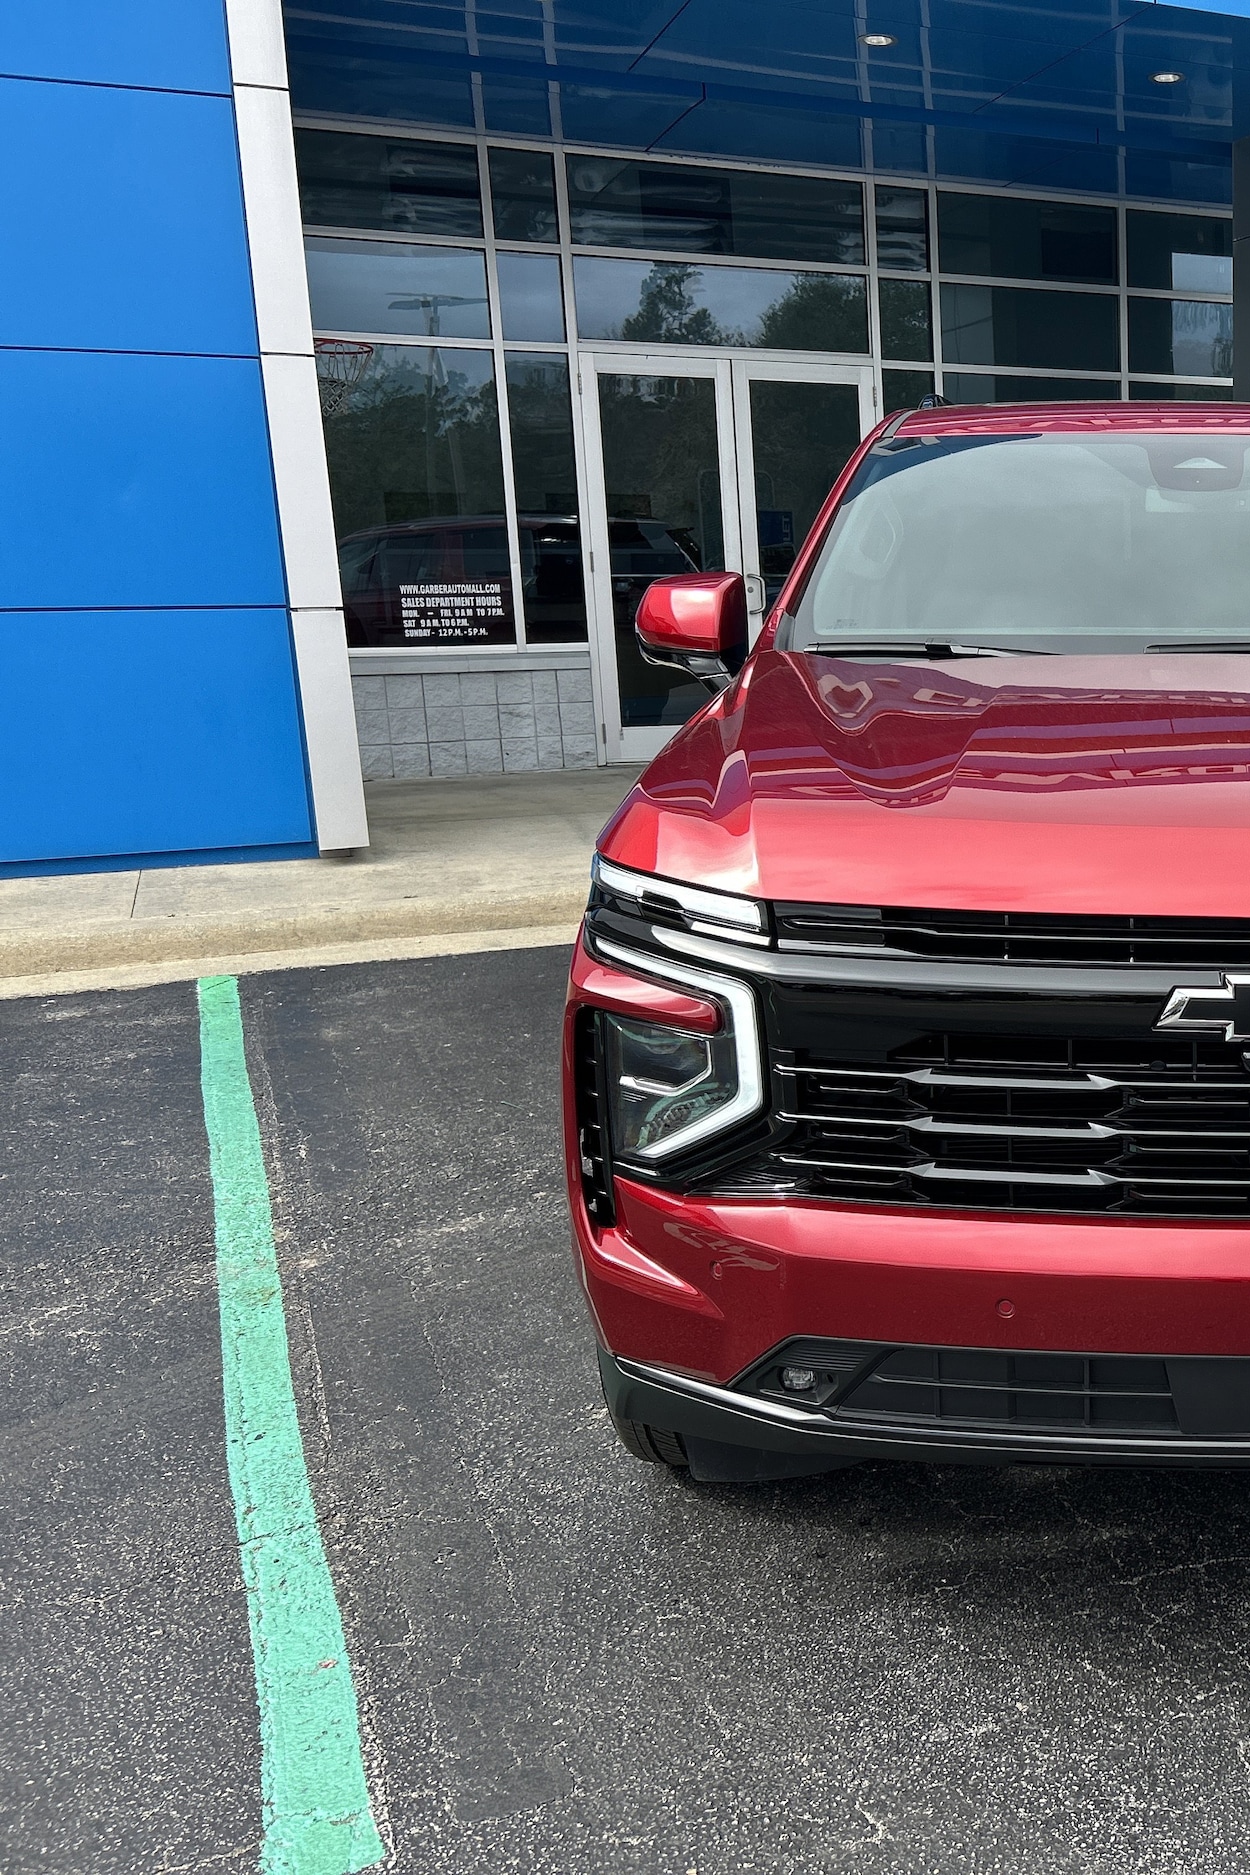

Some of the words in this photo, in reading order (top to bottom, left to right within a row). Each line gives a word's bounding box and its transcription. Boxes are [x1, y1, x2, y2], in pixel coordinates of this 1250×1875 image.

[399, 583, 501, 594] WWW.GARBERAUTOMALL.COM
[401, 597, 425, 608] SALES
[426, 596, 475, 607] DEPARTMENT
[475, 596, 502, 606] HOURS
[403, 620, 416, 628] SAT
